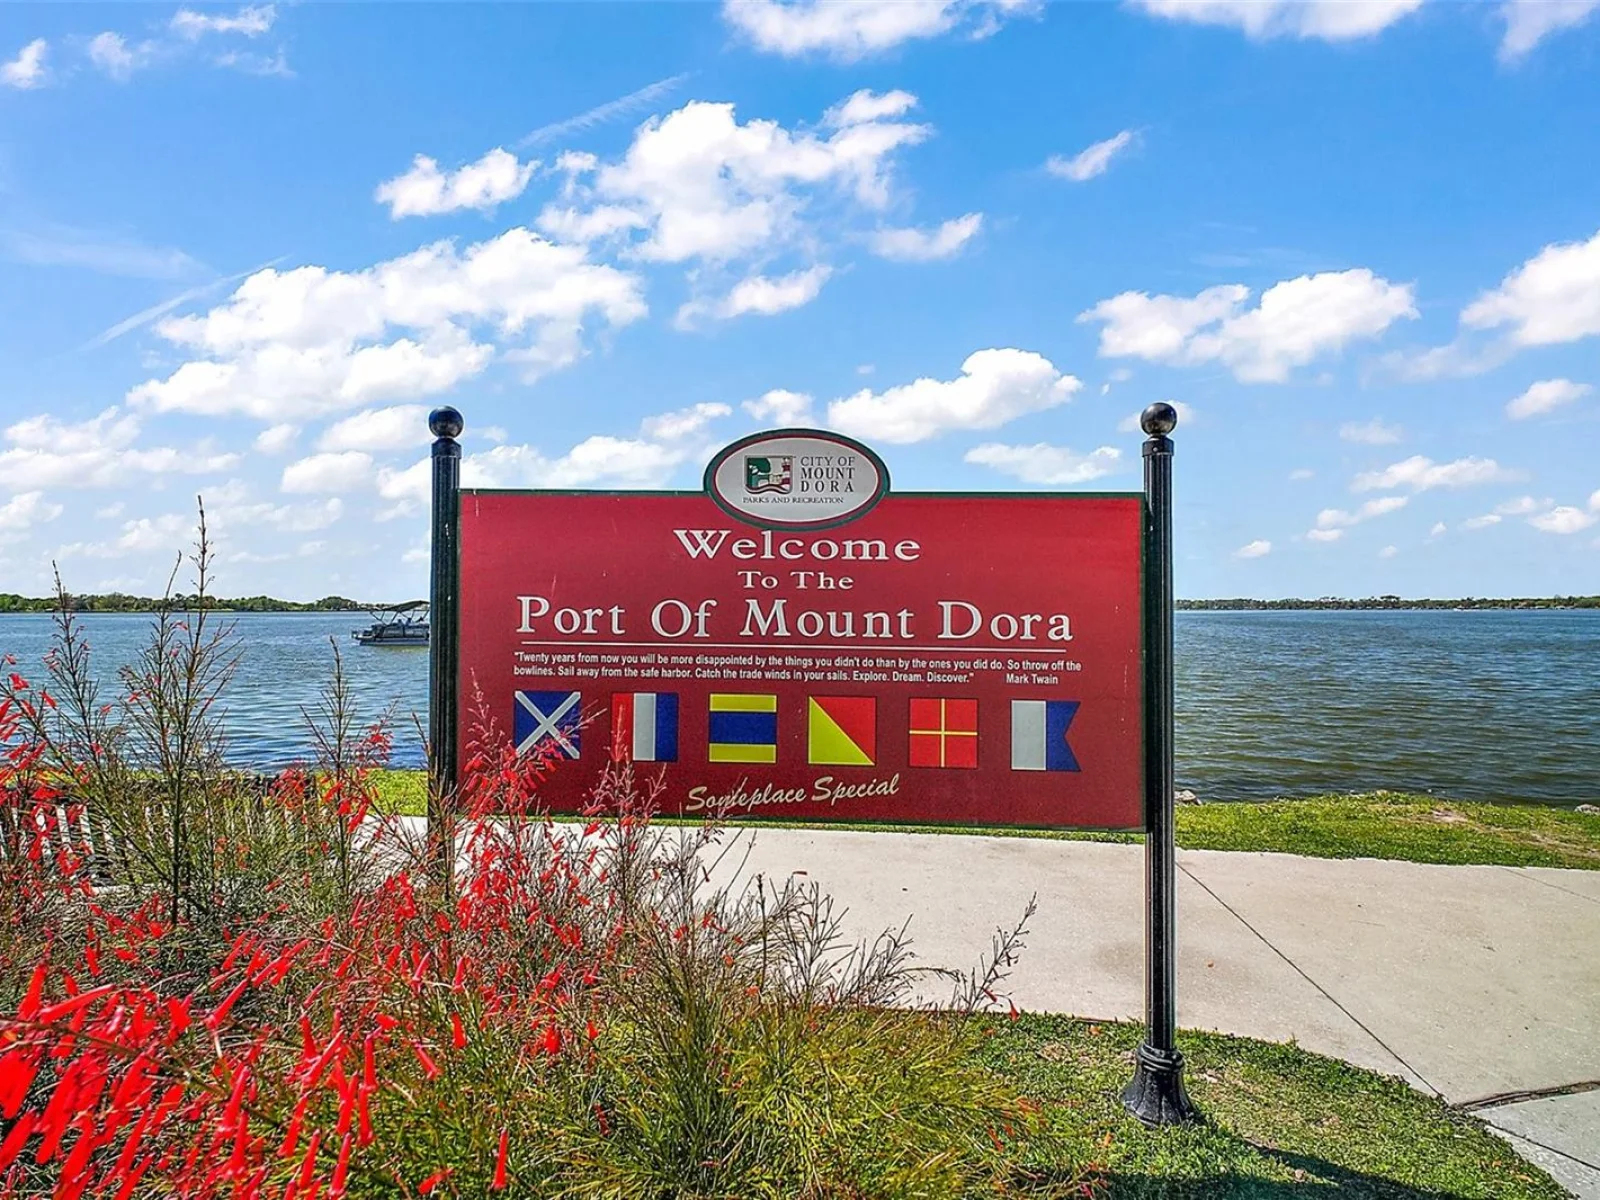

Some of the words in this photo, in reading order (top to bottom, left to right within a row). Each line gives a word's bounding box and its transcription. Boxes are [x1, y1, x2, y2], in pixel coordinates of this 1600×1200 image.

[800, 456, 833, 467] CITY
[837, 456, 856, 467] OF
[800, 467, 855, 480] MOUNT
[800, 480, 855, 493] DORA
[742, 496, 770, 504] PARKS
[771, 496, 790, 504] AND
[792, 496, 844, 504] RECREATION
[673, 529, 921, 561] Welcome
[737, 571, 778, 590] To
[790, 571, 854, 590] The
[516, 596, 626, 635] Port
[651, 599, 718, 638] Of
[739, 599, 915, 639] Mount
[937, 601, 1074, 641] Dora
[514, 651, 549, 664] "Twenty
[551, 654, 576, 665] years
[578, 652, 599, 663] from
[601, 654, 619, 663] now
[621, 654, 639, 665] you
[640, 653, 655, 663] will
[657, 653, 669, 664] be
[671, 655, 694, 664] more
[695, 654, 753, 667] disappointed
[755, 655, 767, 667] by
[768, 656, 783, 666] the
[785, 656, 813, 668] things
[815, 658, 832, 669] you
[834, 656, 860, 667] didn't
[862, 657, 874, 667] do
[876, 658, 896, 668] than
[898, 658, 910, 670] by
[912, 659, 927, 669] the
[929, 660, 951, 669] ones
[953, 660, 971, 671] you
[973, 659, 988, 669] did
[990, 660, 1005, 670] do.
[1007, 660, 1020, 670] So
[1022, 660, 1050, 670] throw
[1051, 660, 1064, 670] off
[1066, 661, 1082, 671] the
[513, 665, 556, 676] bowlines.
[557, 665, 575, 676] Sail
[577, 667, 600, 679] away
[601, 666, 622, 677] from
[624, 667, 638, 677] the
[640, 667, 660, 677] safe
[661, 667, 693, 678] harbor.
[695, 668, 721, 679] Catch
[723, 669, 737, 679] the
[739, 669, 762, 680] trade
[764, 669, 791, 680] winds
[793, 669, 803, 680] in
[804, 671, 825, 682] your
[826, 670, 850, 681] sails.
[853, 671, 890, 682] Explore.
[892, 671, 925, 683] Dream.
[927, 672, 975, 684] Discover."
[1006, 673, 1029, 684] Mark
[1031, 673, 1059, 685] Twain
[811, 773, 900, 806] Special
